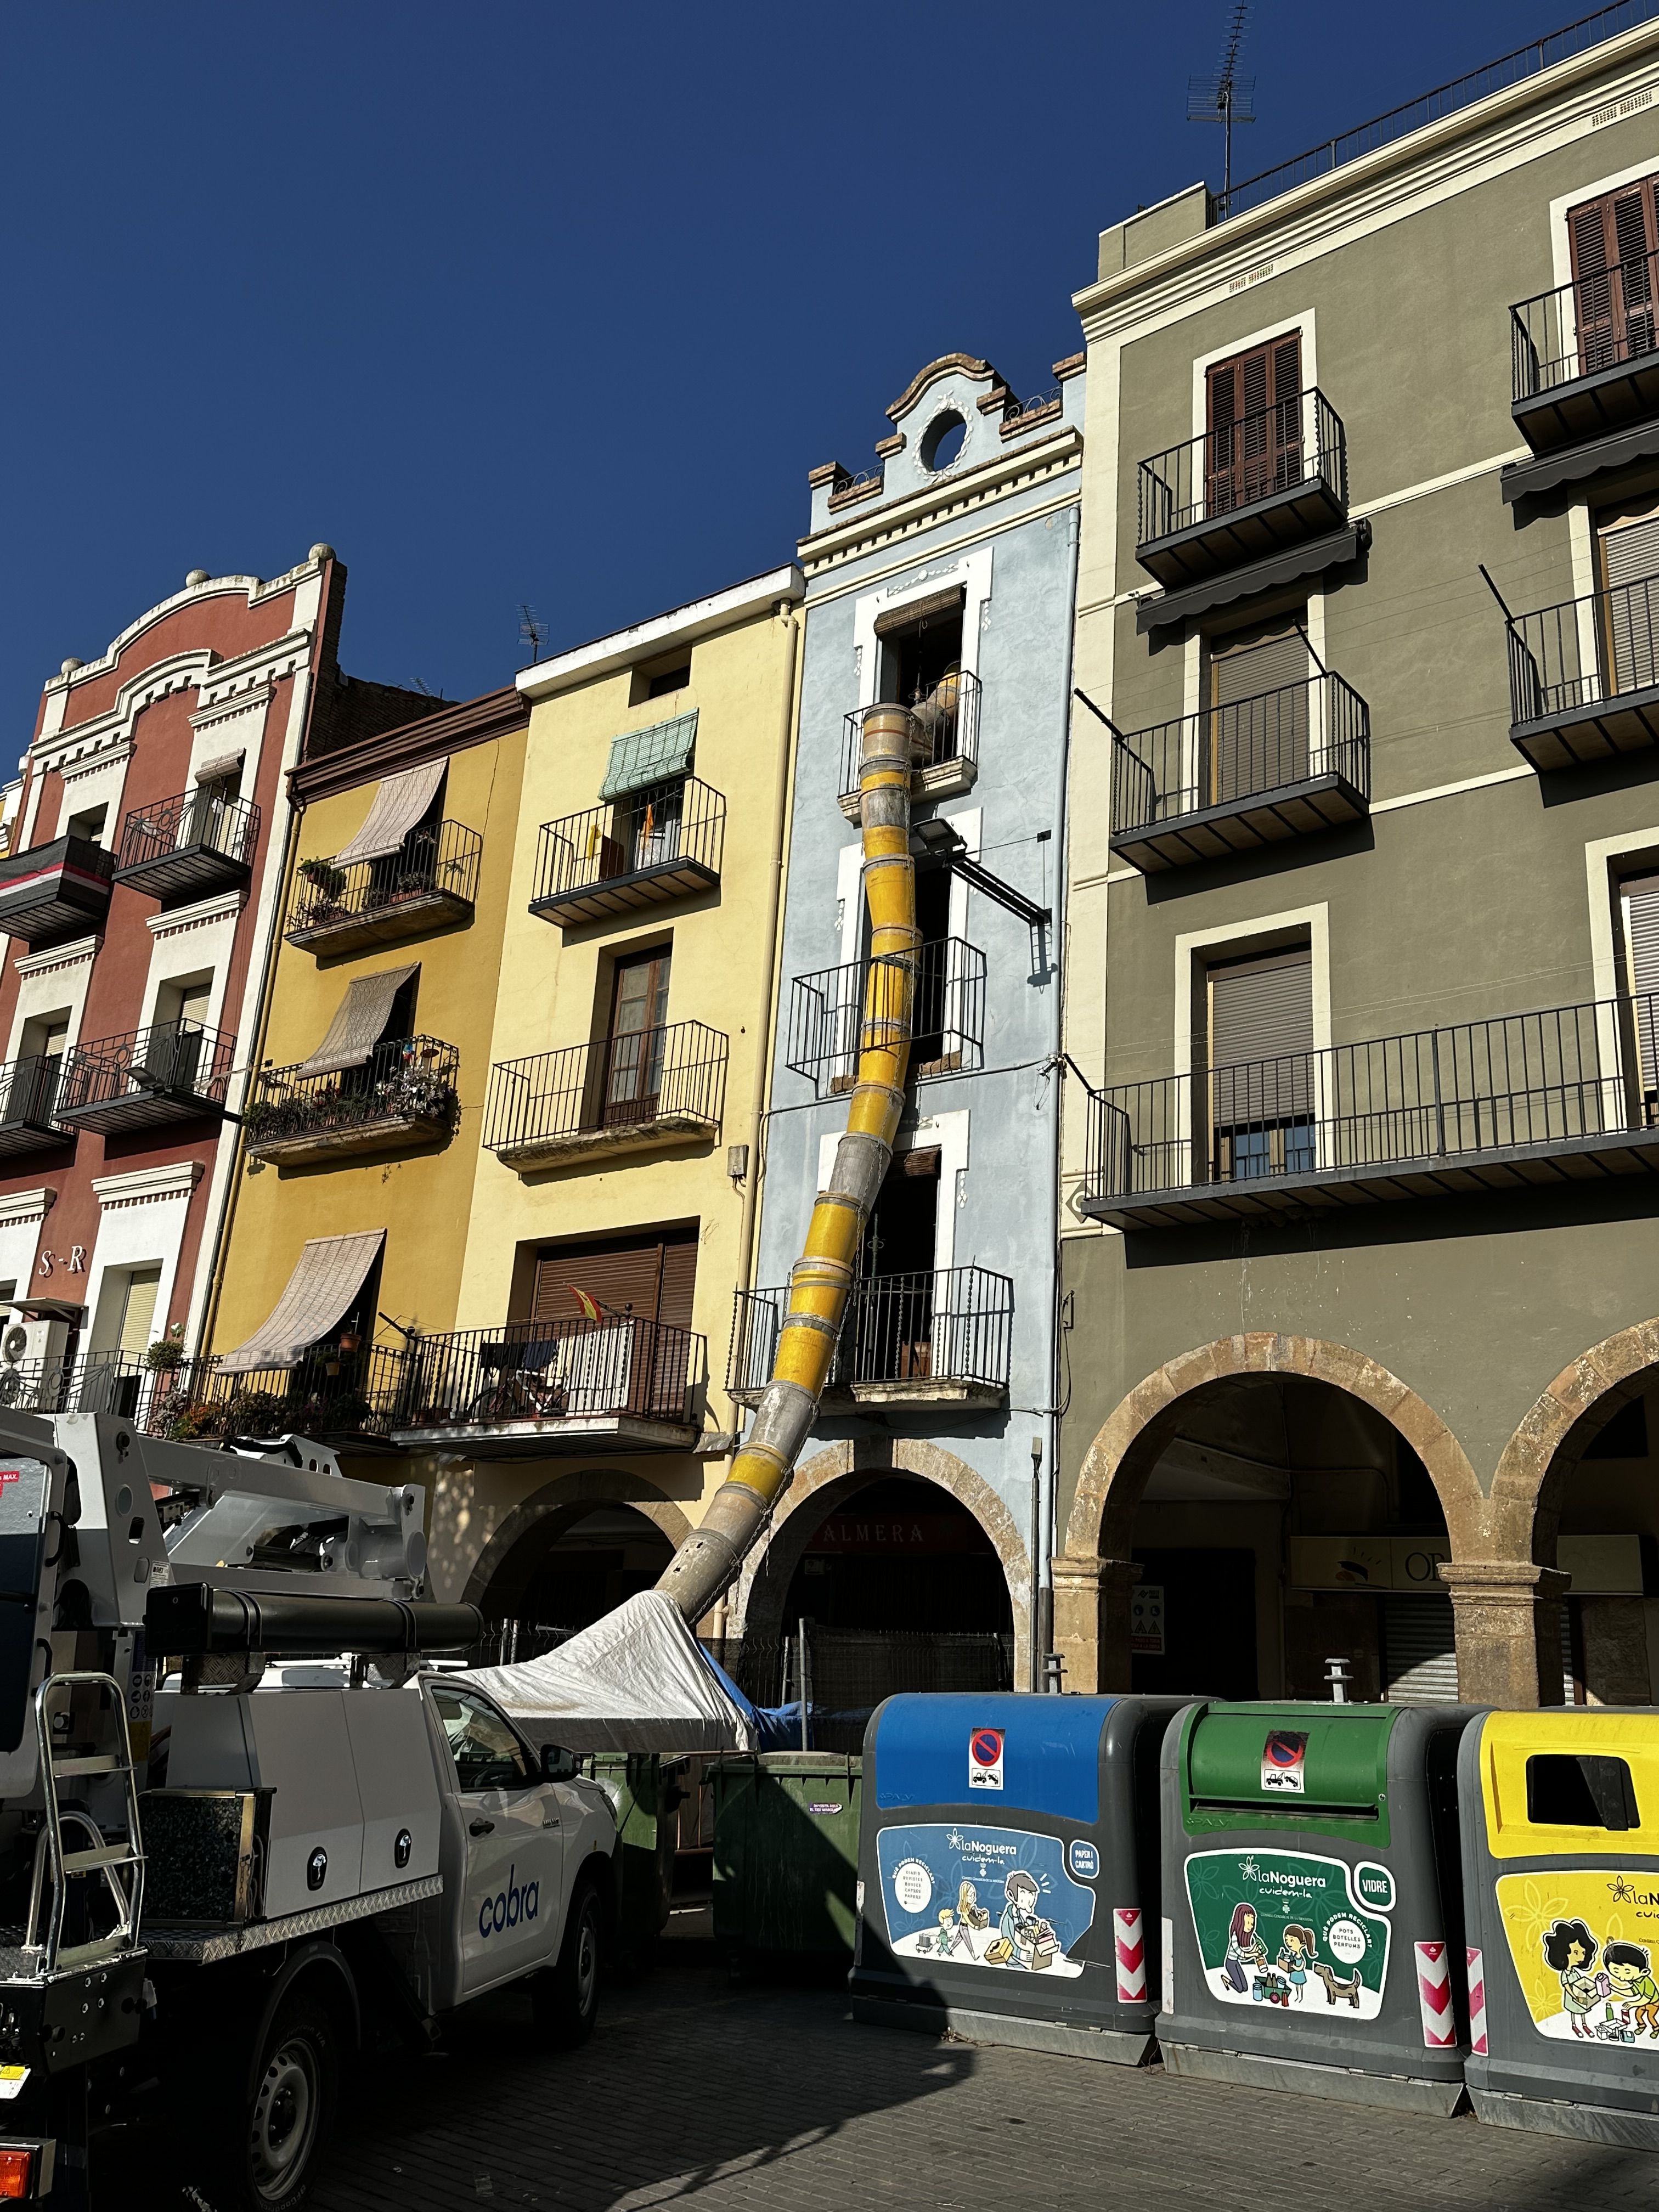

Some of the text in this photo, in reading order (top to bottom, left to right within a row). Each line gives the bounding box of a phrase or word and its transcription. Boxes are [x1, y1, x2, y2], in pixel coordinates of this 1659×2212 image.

[962, 1839, 1017, 1855] laNoguera
[962, 1852, 1005, 1865] cuidem-la
[1075, 1850, 1091, 1858] PAPER
[1075, 1860, 1094, 1870] CARTRÓ
[1258, 1870, 1326, 1887] laNoguera
[1259, 1886, 1312, 1898] cuidem-la
[1362, 1880, 1388, 1893] VIDRE
[479, 1864, 539, 1938] cobra
[1326, 1912, 1347, 1926] PODEM
[1348, 1914, 1373, 1948] RECICLAR?
